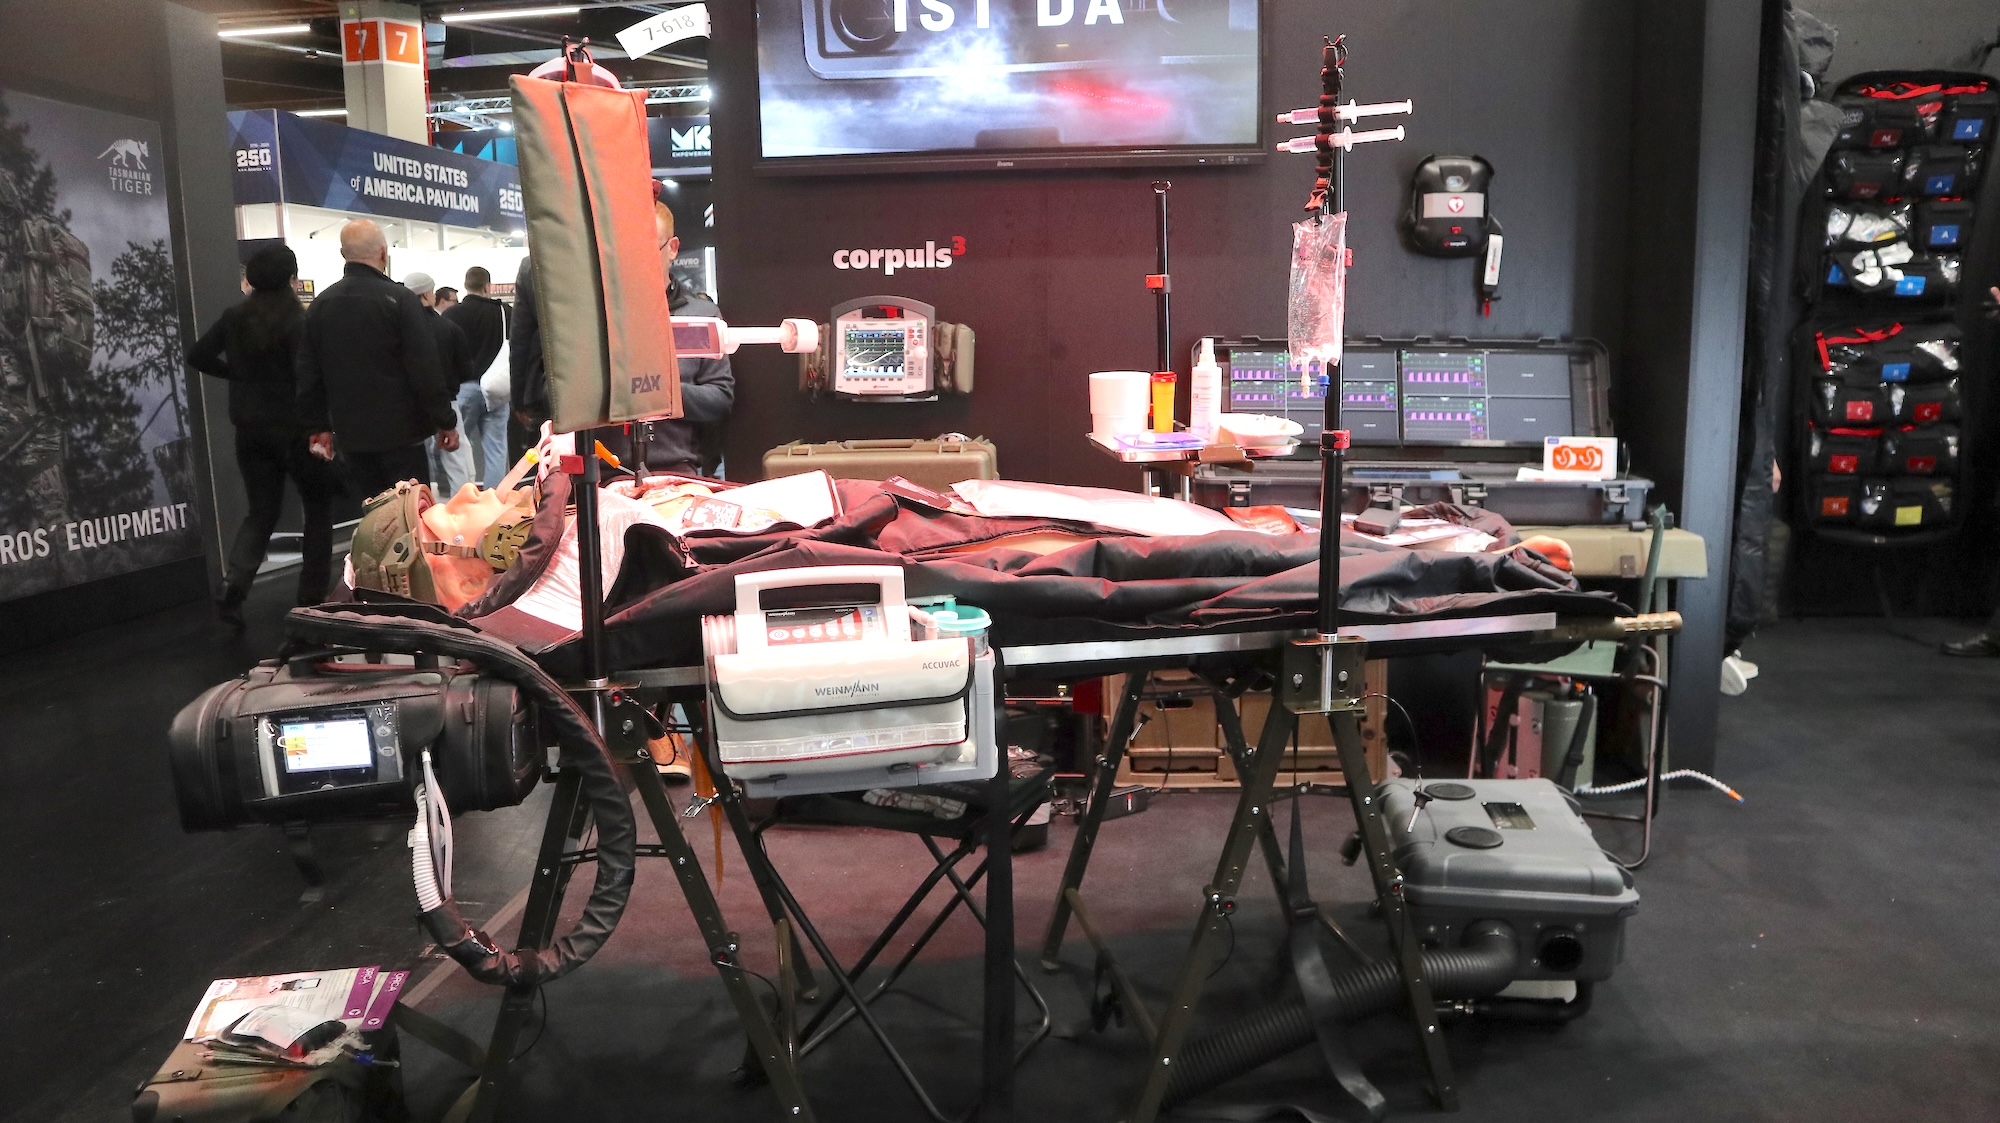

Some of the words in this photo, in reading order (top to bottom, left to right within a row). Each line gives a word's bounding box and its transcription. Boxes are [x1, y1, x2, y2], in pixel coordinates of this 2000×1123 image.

[642, 14, 695, 41] 7-618
[354, 29, 368, 54] 7
[395, 30, 408, 55] 7
[236, 148, 271, 168] 250
[373, 151, 422, 179] UNITED
[424, 162, 468, 188] STATES
[108, 166, 152, 182] TASMANIAN
[110, 177, 152, 196] TIGER
[350, 175, 361, 192] of
[363, 176, 425, 205] AMERICA
[426, 187, 479, 213] PAVILION
[499, 188, 523, 212] 250
[631, 372, 661, 395] PAX
[65, 502, 187, 551] EQUIPMENT
[922, 659, 960, 670] ACCUVAC
[815, 680, 879, 698] WEINMANN
